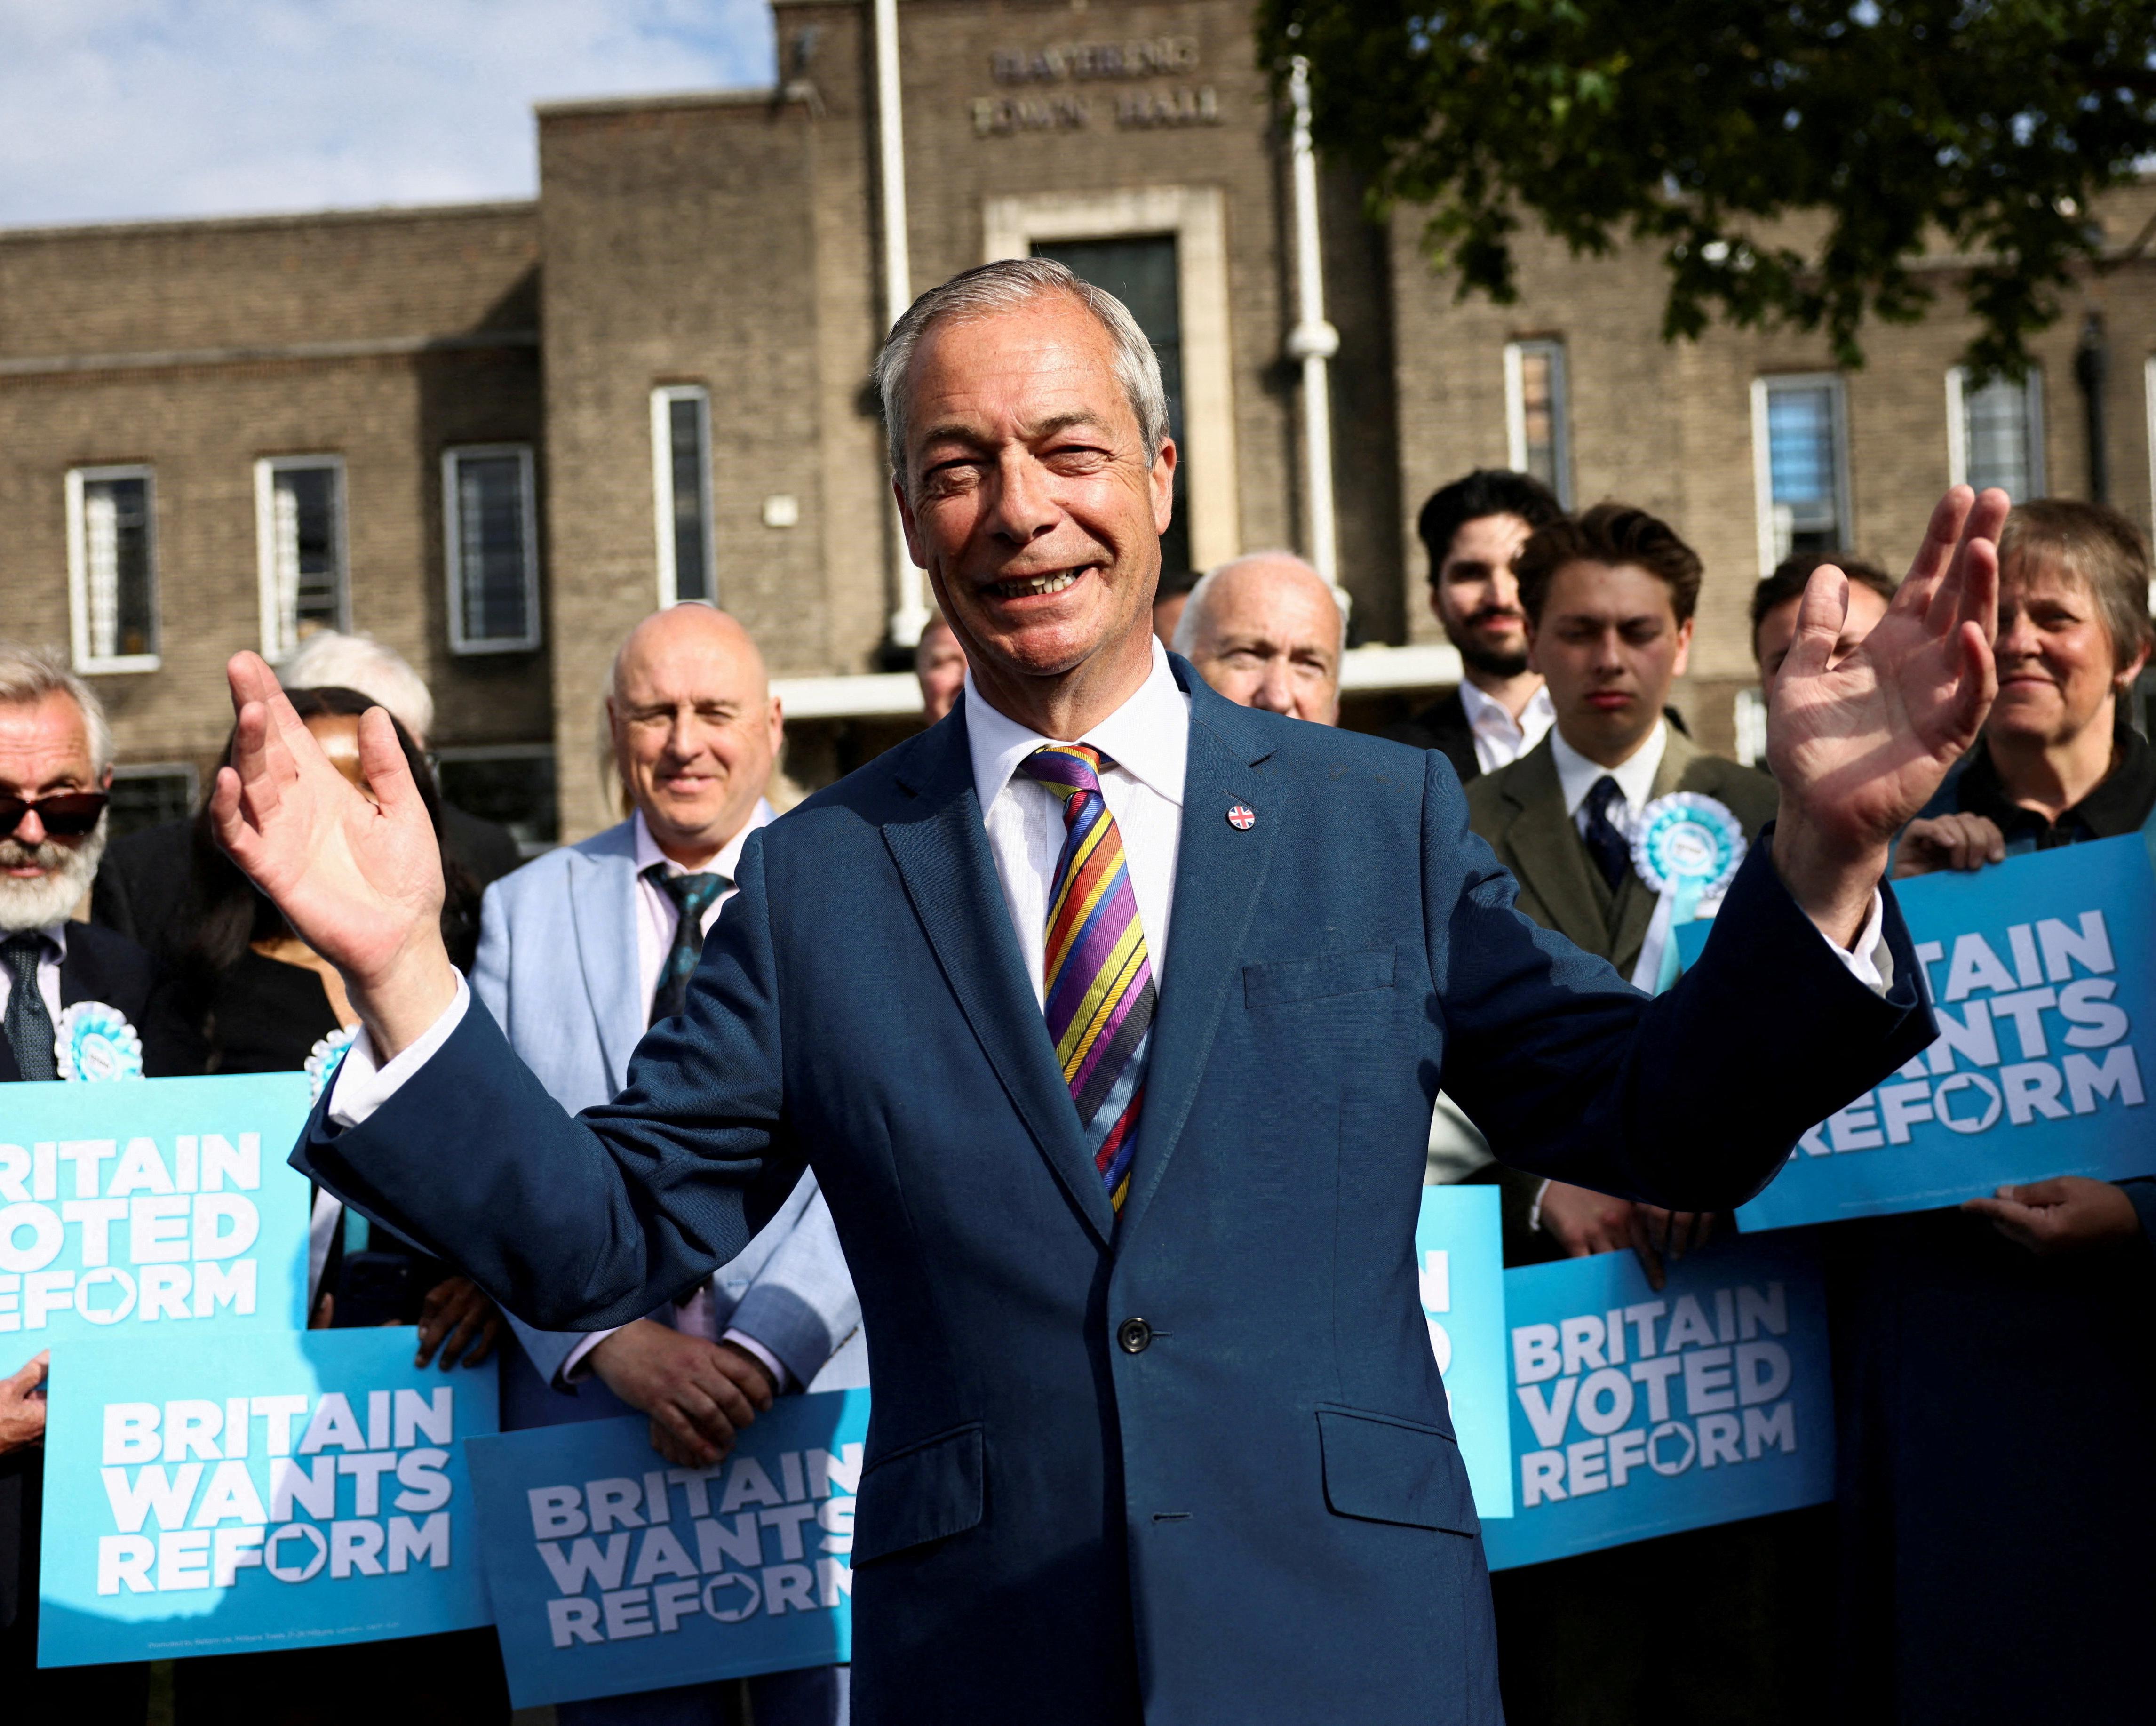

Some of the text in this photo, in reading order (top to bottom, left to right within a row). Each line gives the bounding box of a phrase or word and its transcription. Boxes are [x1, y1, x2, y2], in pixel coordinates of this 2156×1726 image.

[972, 94, 1090, 136] TOWN
[1915, 909, 2116, 1004] TAIN
[1893, 977, 2129, 1079] NTS
[0, 1192, 260, 1274] OTED
[1511, 1281, 1789, 1385] BRITAIN
[102, 1386, 453, 1465] BRITAIN
[1515, 1341, 1792, 1449] VOTED
[100, 1448, 453, 1533] WANTS
[527, 1442, 865, 1540] BRITAIN
[1521, 1403, 1796, 1508] REFORM
[97, 1511, 451, 1596] REFORM
[535, 1496, 856, 1596] WANTS
